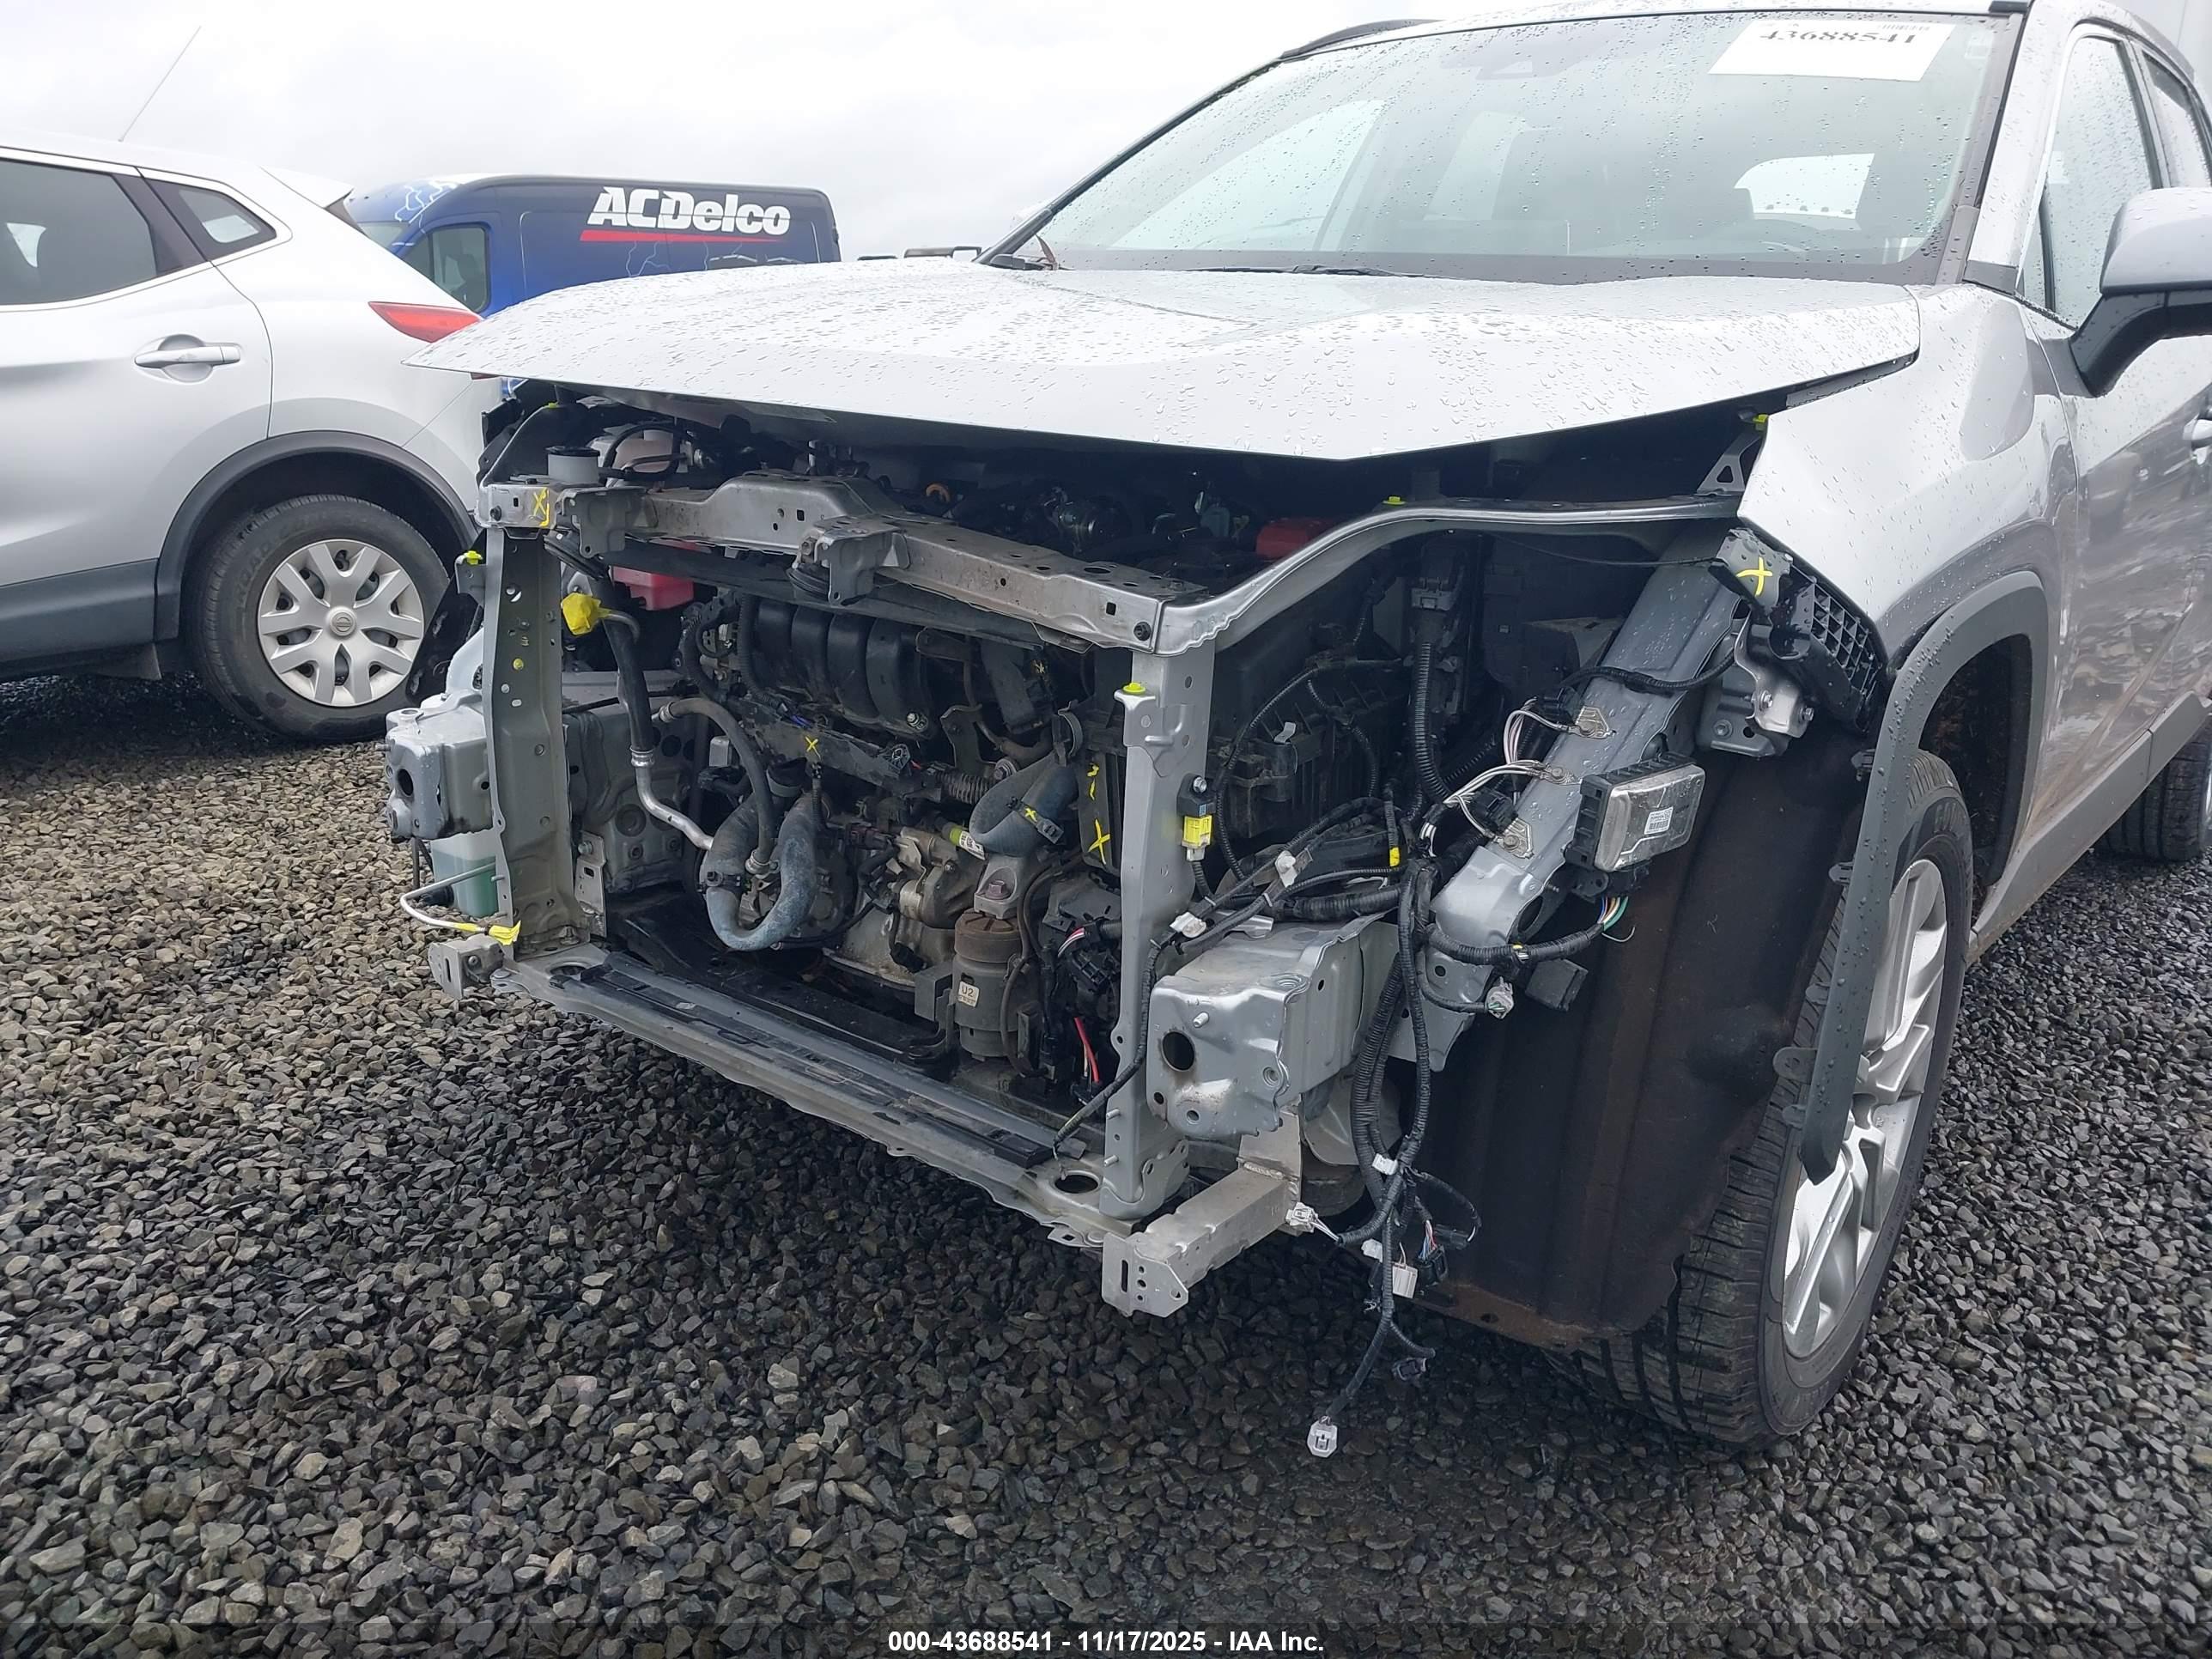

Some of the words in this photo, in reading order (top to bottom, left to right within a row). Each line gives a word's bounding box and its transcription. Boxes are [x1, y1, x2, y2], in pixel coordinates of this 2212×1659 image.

[1759, 30, 1916, 44] 43688541
[586, 186, 791, 235] ACDelco
[962, 984, 974, 997] U2
